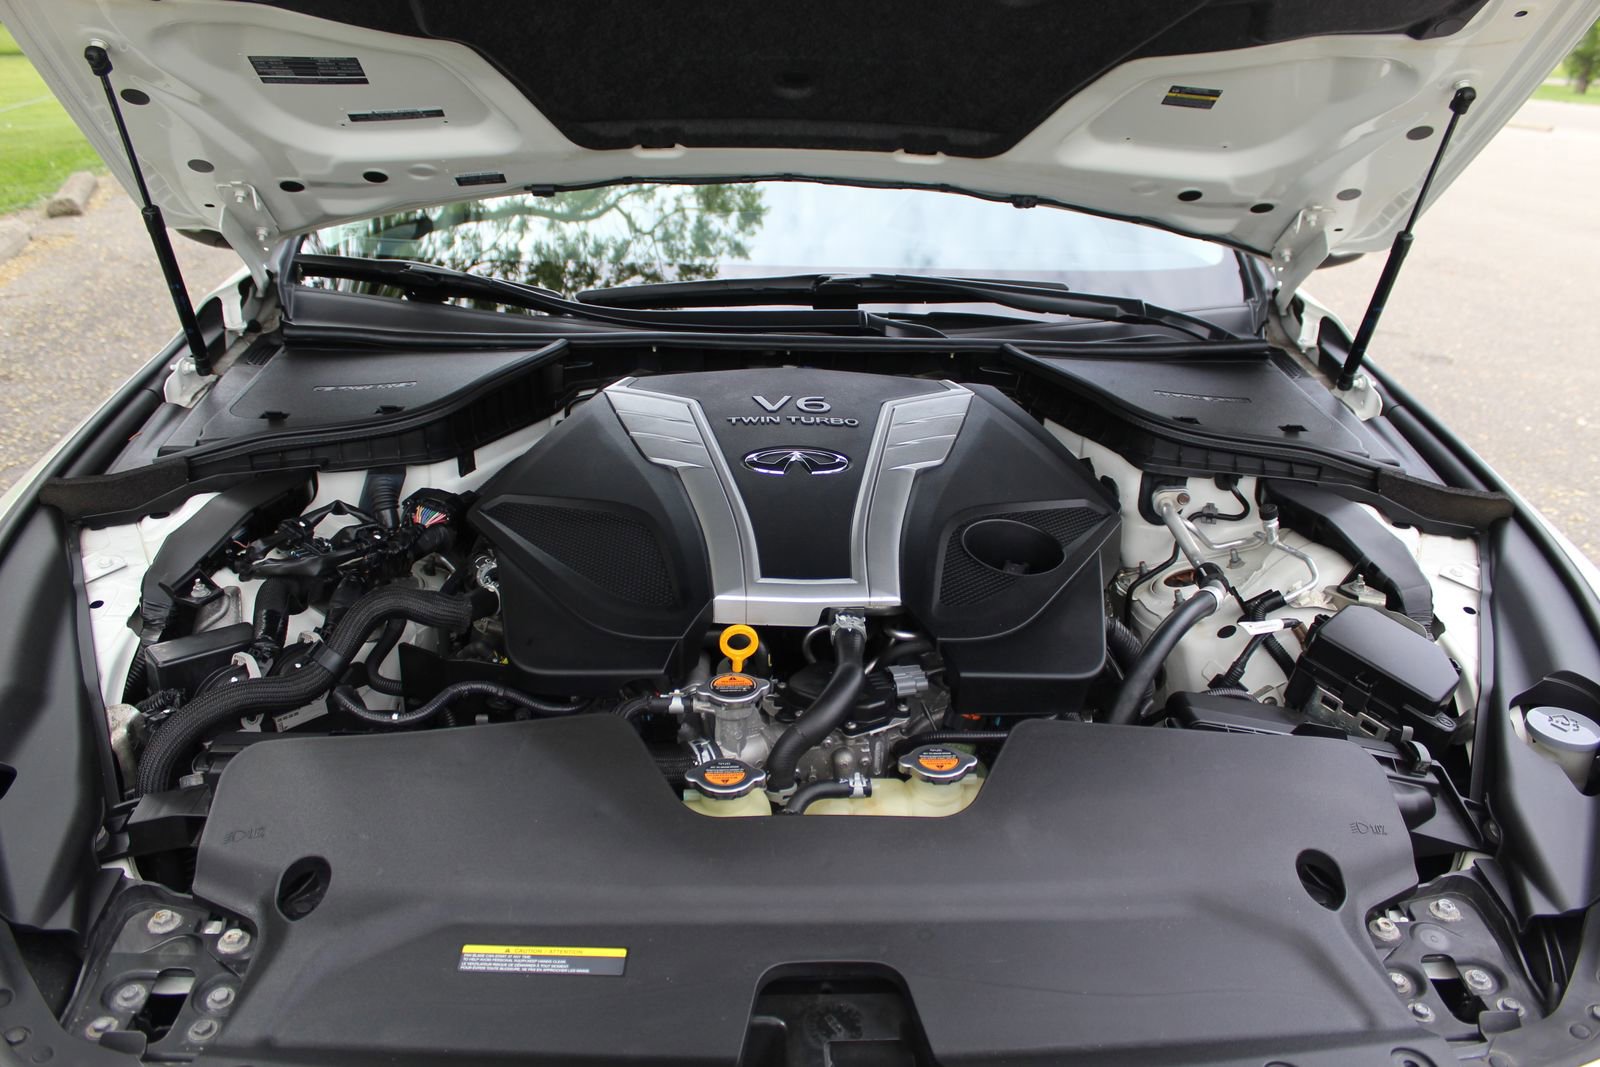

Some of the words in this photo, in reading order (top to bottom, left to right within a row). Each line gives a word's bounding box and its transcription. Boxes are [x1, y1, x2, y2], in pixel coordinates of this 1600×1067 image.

[752, 395, 831, 413] V6
[727, 416, 780, 425] TWIN
[787, 415, 859, 427] TURBO
